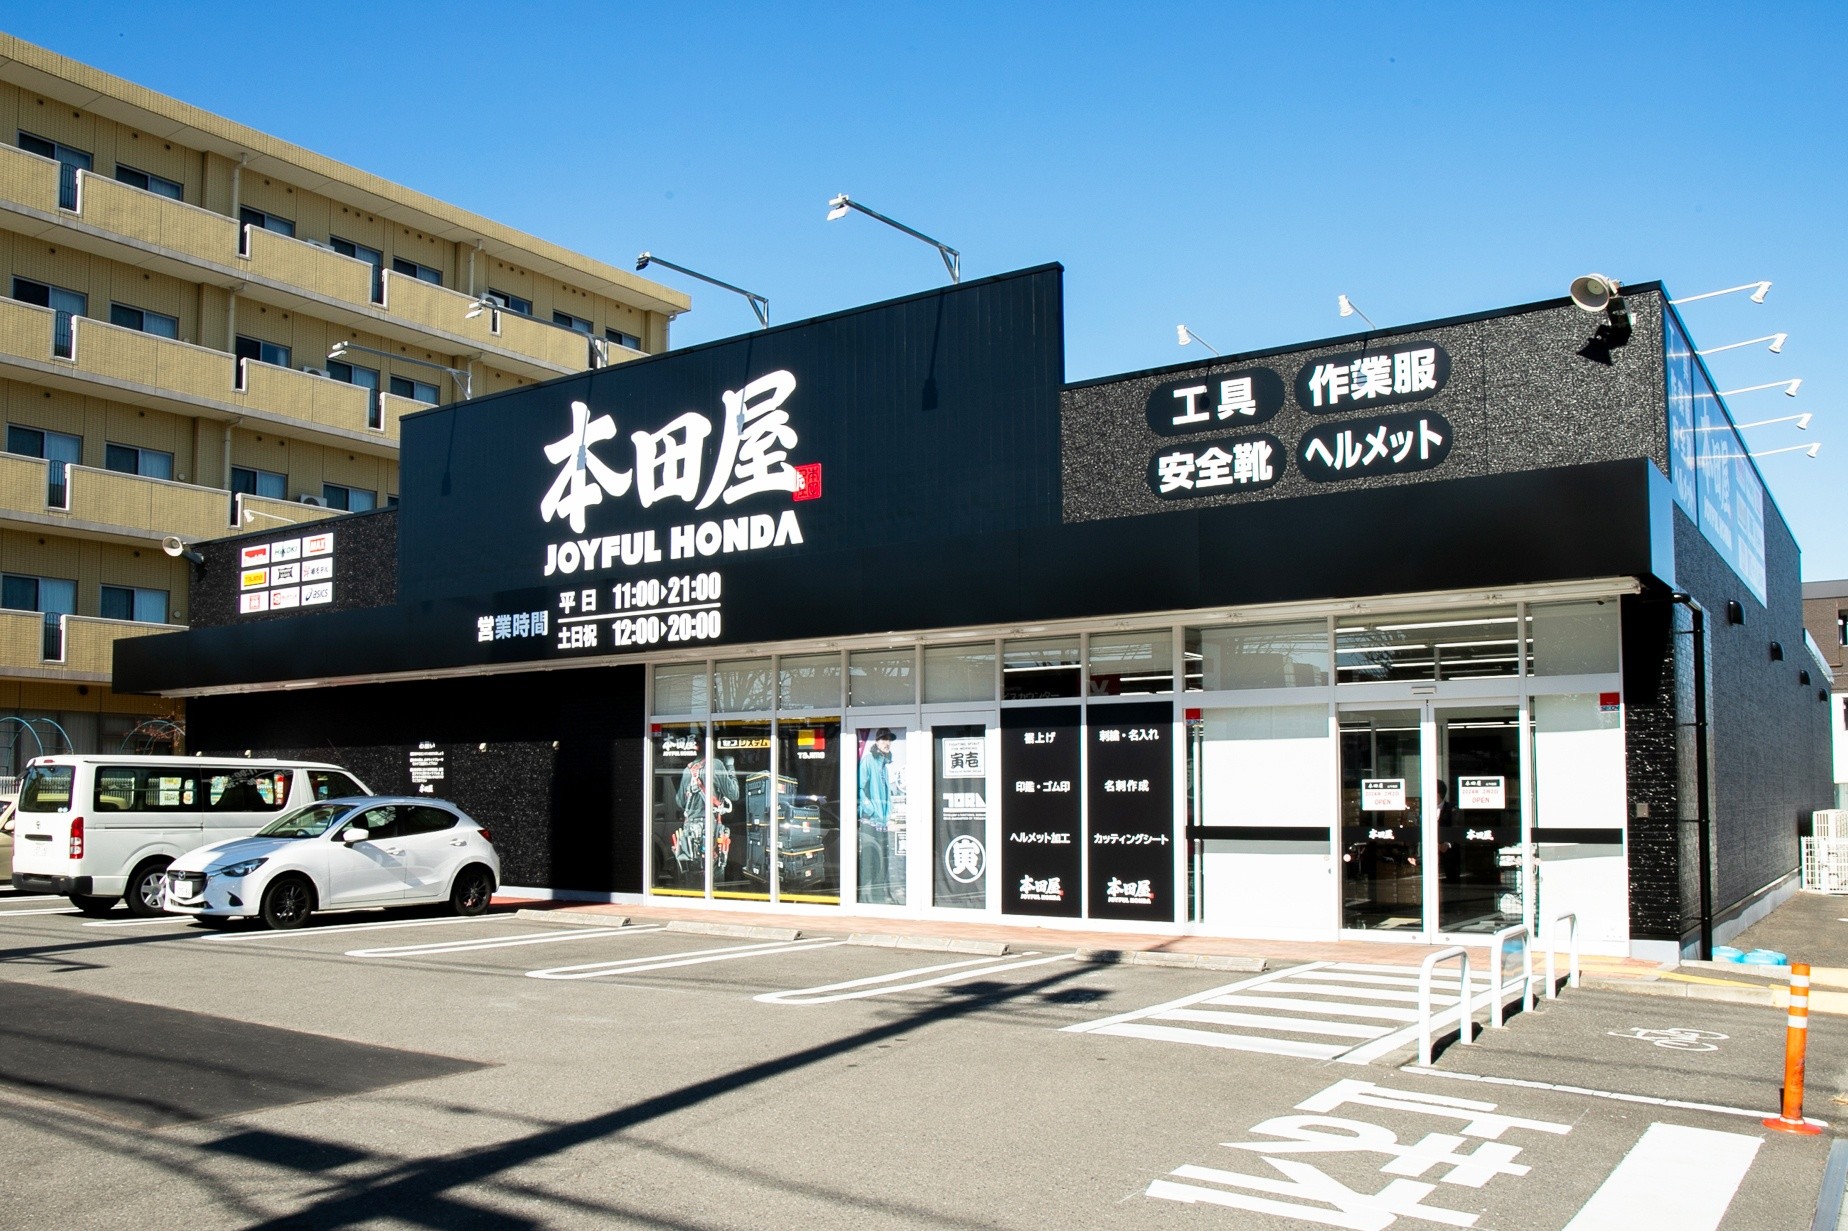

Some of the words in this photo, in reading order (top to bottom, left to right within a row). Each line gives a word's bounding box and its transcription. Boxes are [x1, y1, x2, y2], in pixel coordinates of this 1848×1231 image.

[1309, 348, 1437, 406] 作業服
[1172, 376, 1257, 425] 工具
[540, 369, 799, 534] 本田屋
[1305, 419, 1443, 470] ヘルメット
[1158, 440, 1273, 493] 安全靴
[544, 529, 662, 576] JOYFUL
[670, 509, 804, 560] HONDA
[477, 610, 549, 642] 営業時間
[557, 624, 597, 649] 土日祝
[662, 733, 696, 751] 本田屋
[1024, 732, 1056, 744] 裾上げ
[951, 751, 978, 769] 寅壱
[1104, 780, 1149, 792] 名刺作成
[1010, 832, 1071, 845] ヘルメット加工
[1094, 834, 1169, 845] カッティングシート
[1020, 874, 1060, 894] 本田屋
[1107, 877, 1150, 897] 本田屋
[1145, 1078, 1573, 1231] 止まれ
